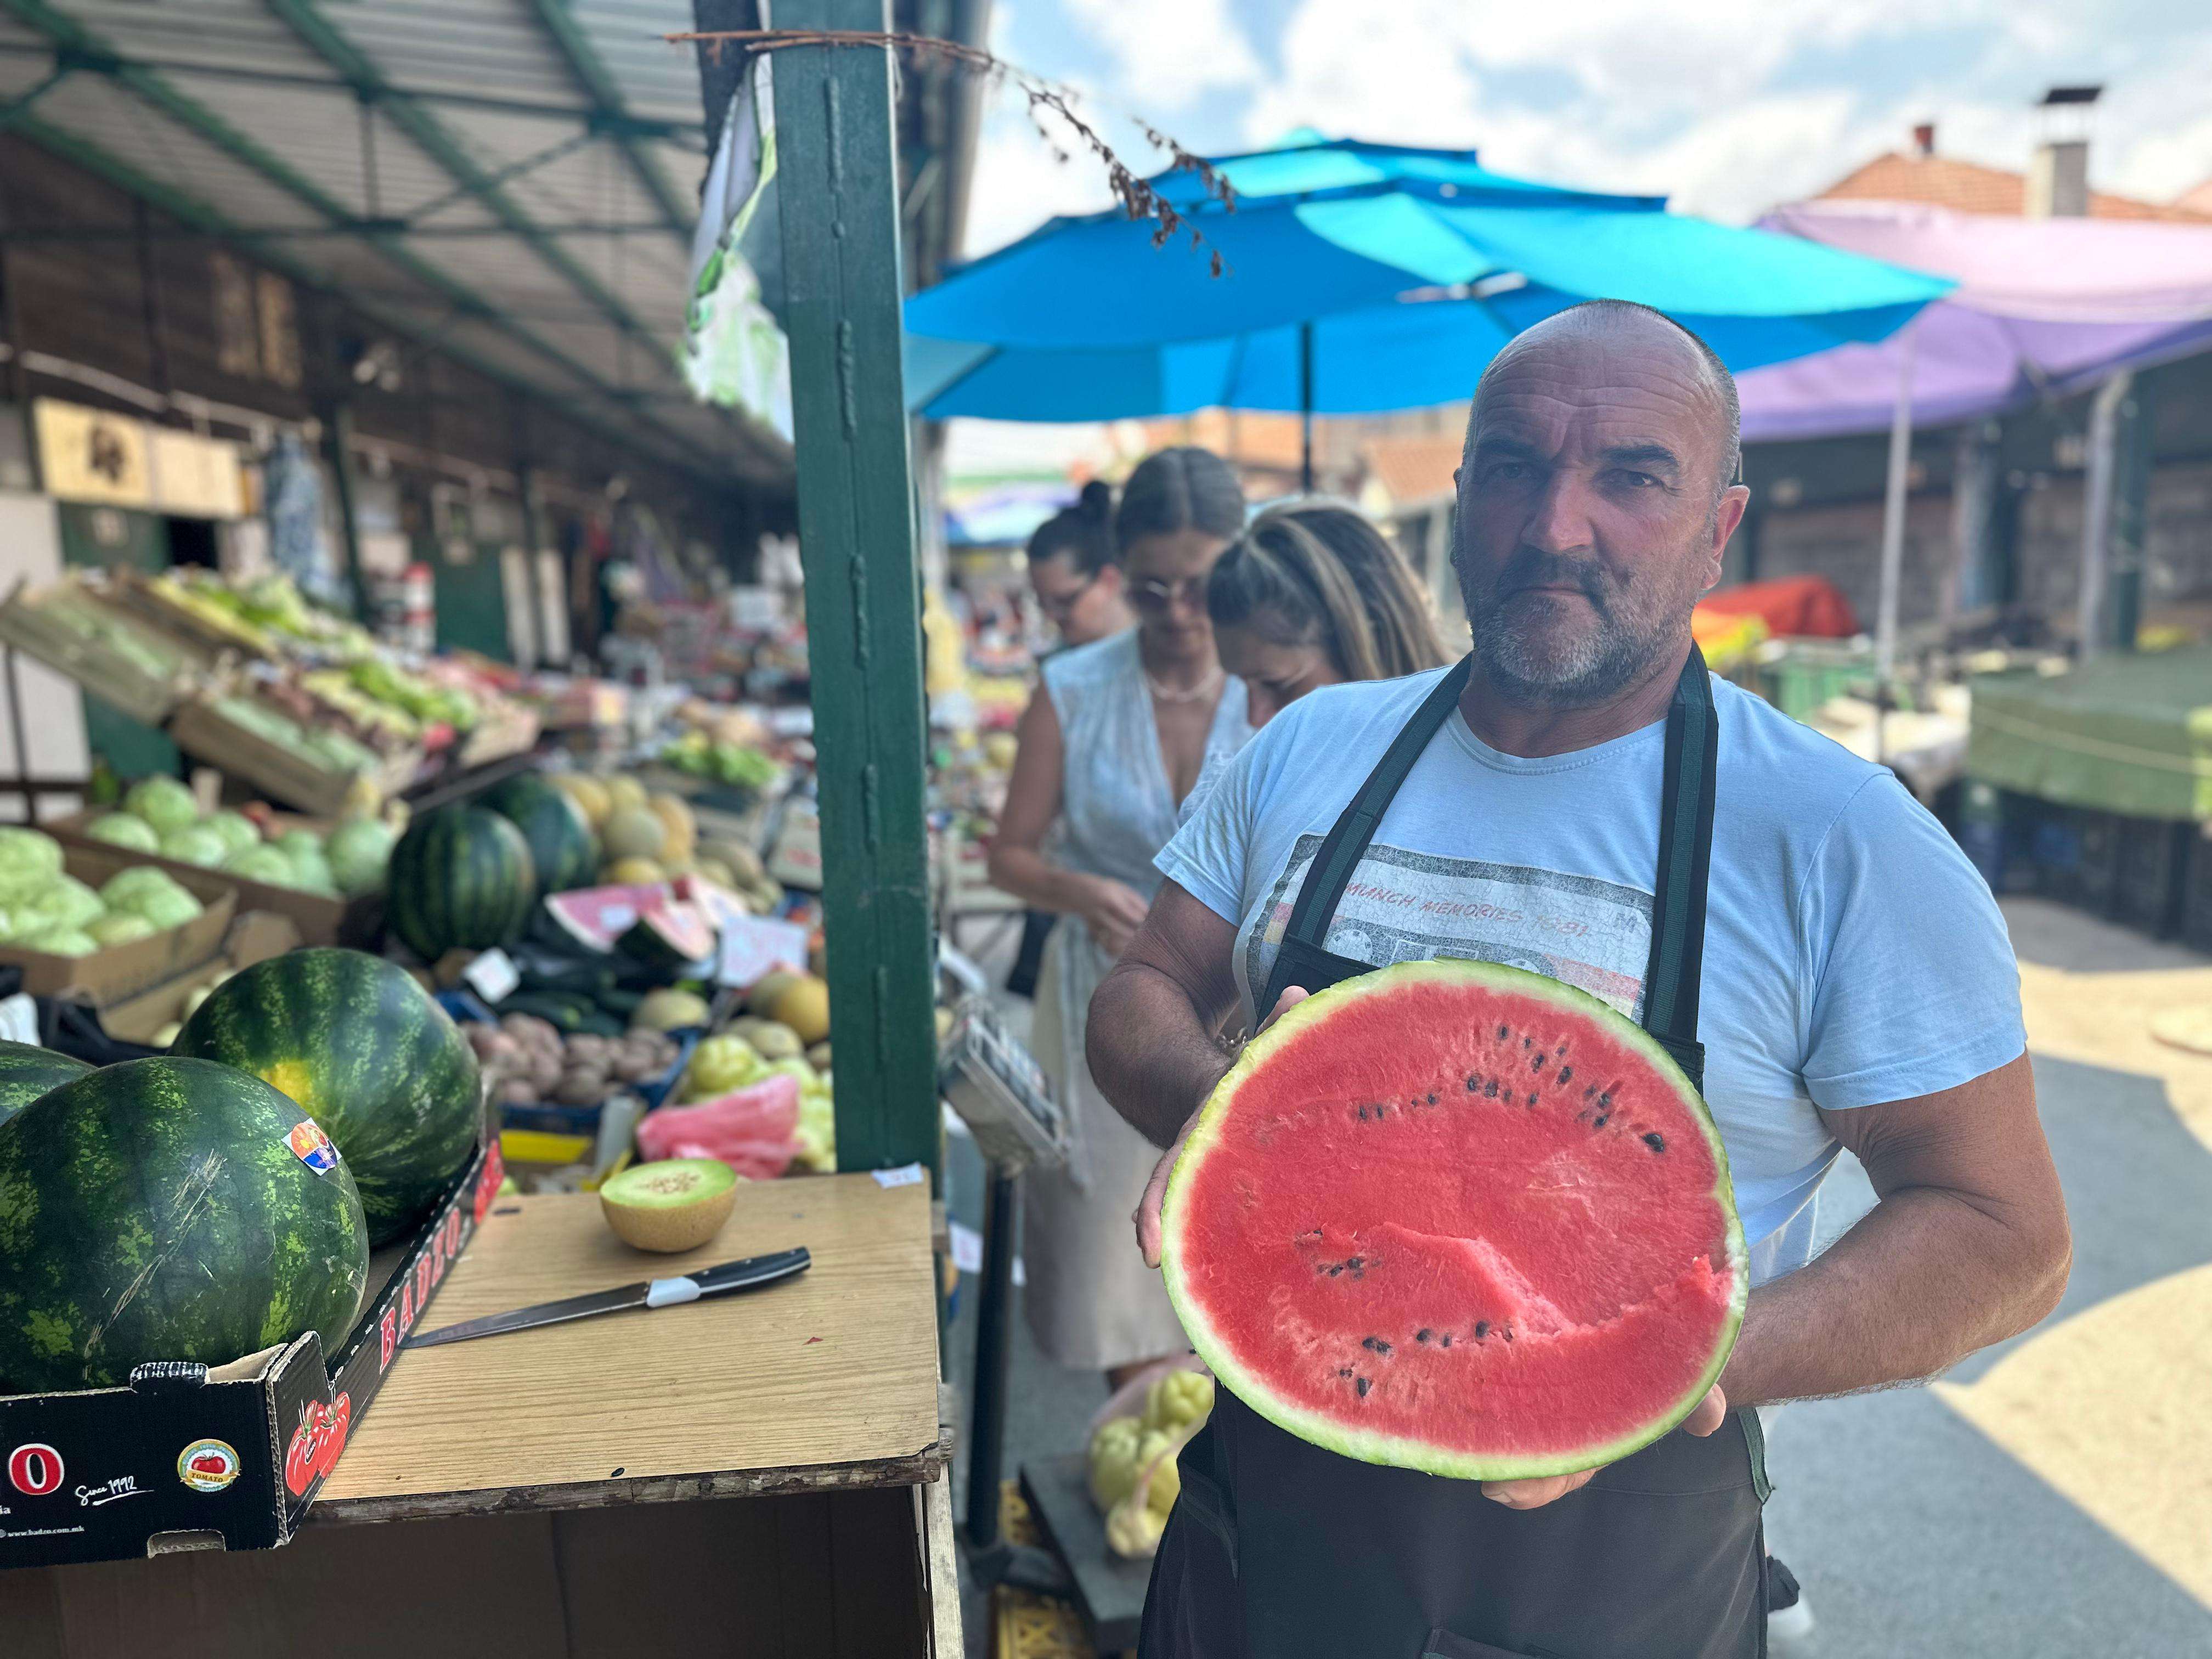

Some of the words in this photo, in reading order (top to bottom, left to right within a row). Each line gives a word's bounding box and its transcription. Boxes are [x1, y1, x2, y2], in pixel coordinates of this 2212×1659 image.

[1419, 900, 1523, 923] MEMORIES
[191, 1472, 224, 1483] TOMATO
[75, 1485, 108, 1506] Since
[108, 1475, 137, 1495] 1992
